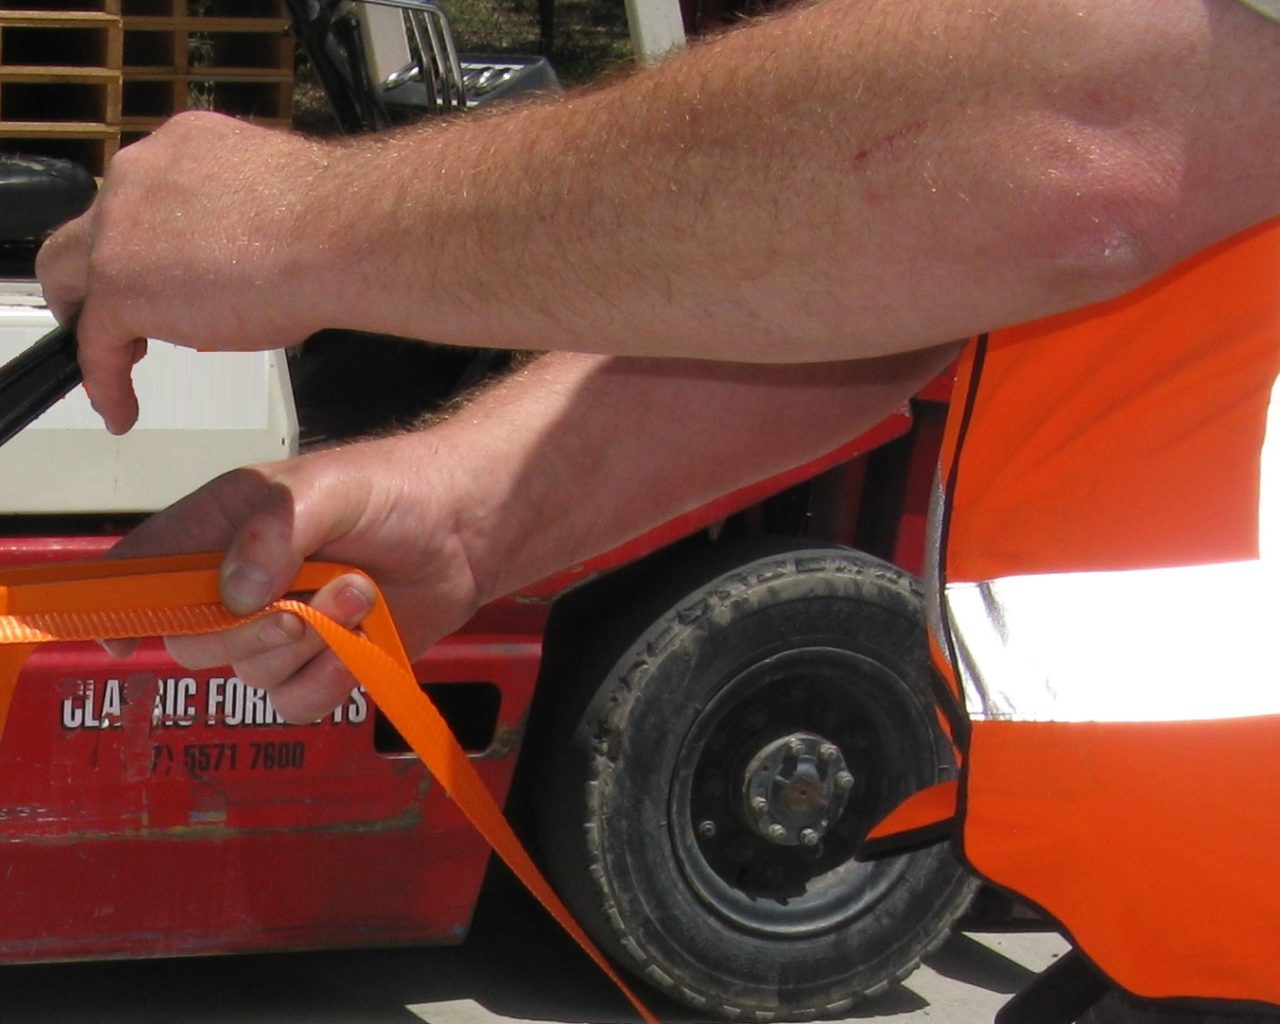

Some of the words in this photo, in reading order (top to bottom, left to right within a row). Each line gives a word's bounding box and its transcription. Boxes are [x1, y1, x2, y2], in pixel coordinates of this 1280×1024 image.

[61, 677, 197, 729] CLAIC
[183, 743, 238, 771] 5571
[250, 740, 307, 769] 7600
